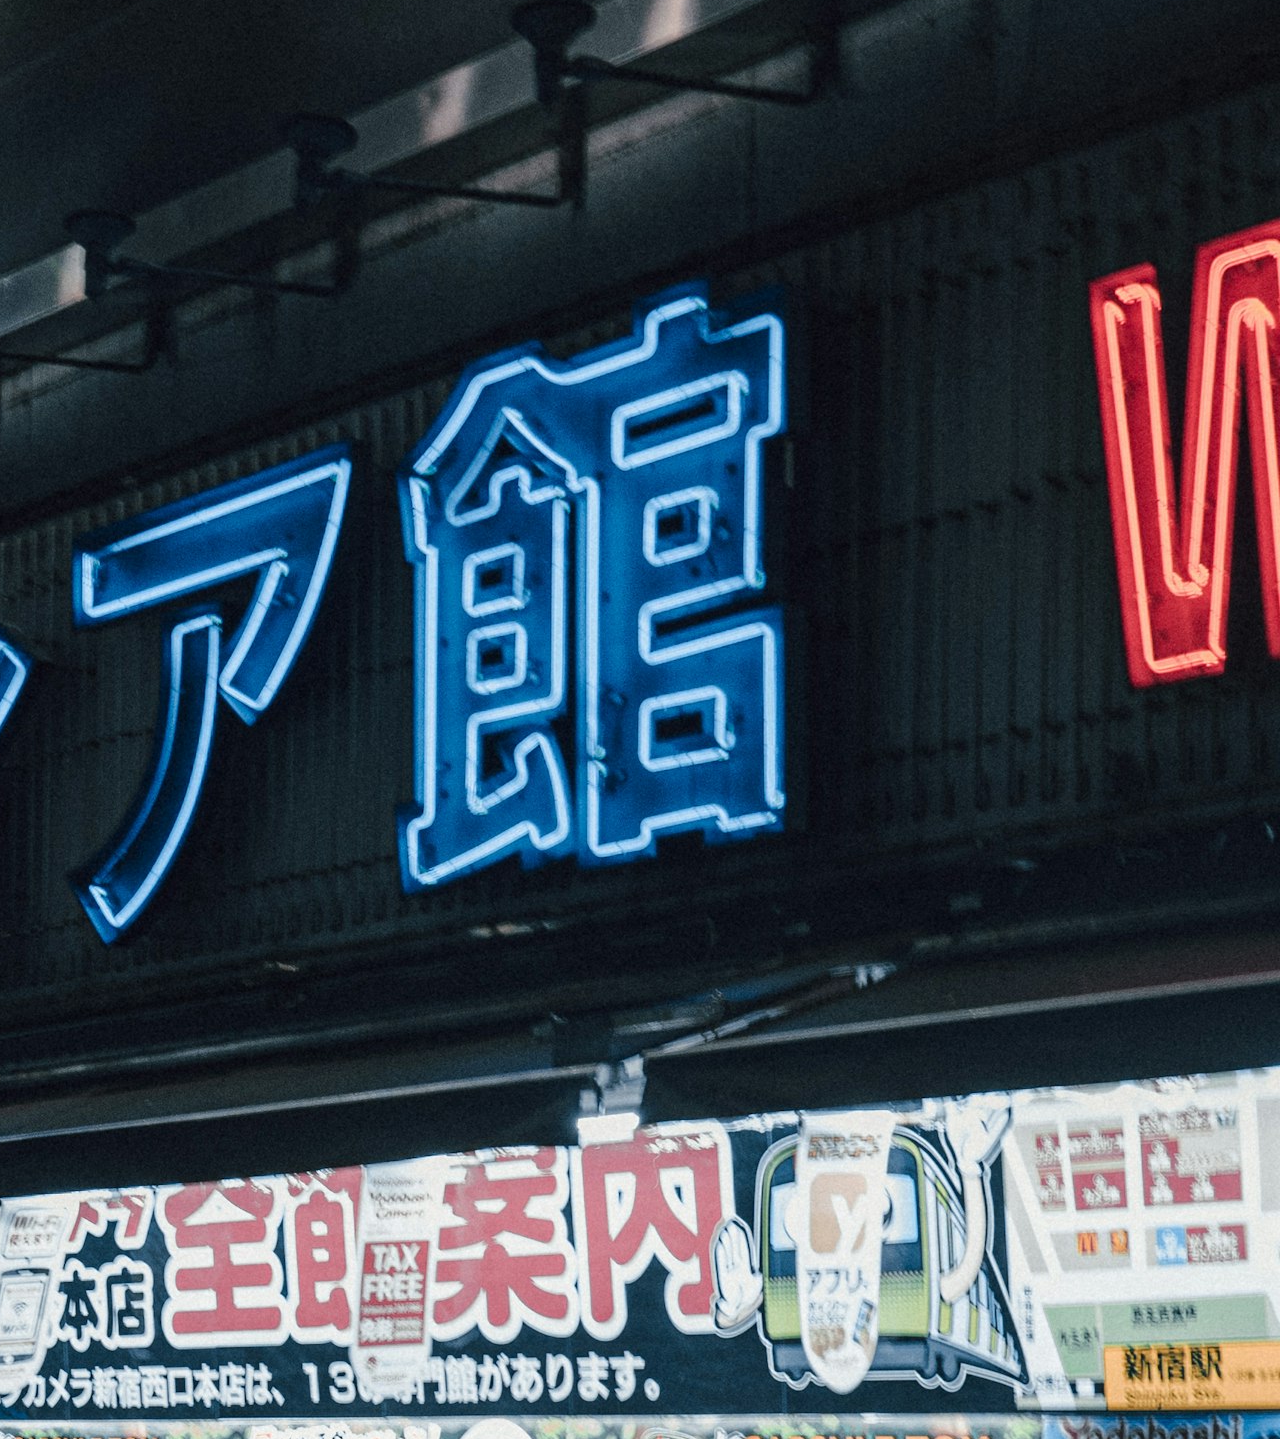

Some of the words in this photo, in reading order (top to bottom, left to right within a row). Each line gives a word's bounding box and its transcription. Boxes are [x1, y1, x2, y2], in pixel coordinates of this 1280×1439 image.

[371, 1242, 423, 1274] TAX
[362, 1272, 425, 1303] FREE
[1124, 1345, 1222, 1383] 新宿駅
